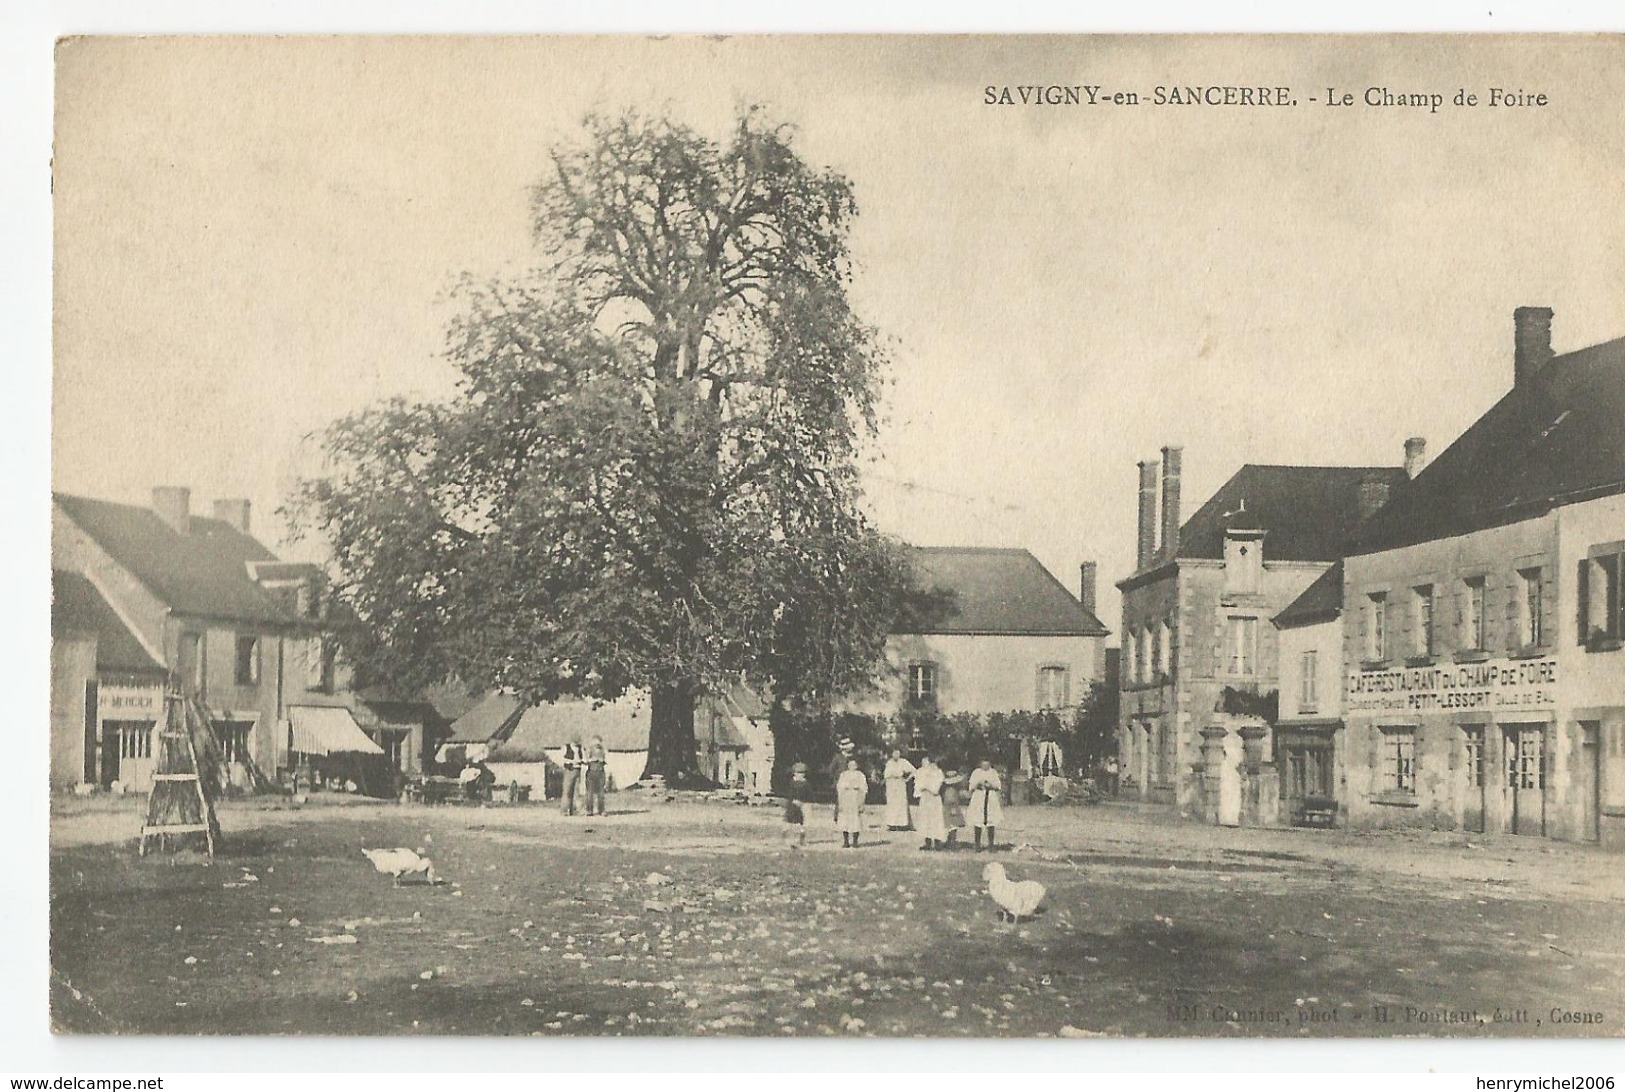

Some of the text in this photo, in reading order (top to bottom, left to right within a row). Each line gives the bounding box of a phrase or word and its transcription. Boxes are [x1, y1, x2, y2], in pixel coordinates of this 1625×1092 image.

[1459, 665, 1498, 690] CHAMP
[1501, 669, 1516, 685] DE
[1520, 661, 1556, 685] FOIRE
